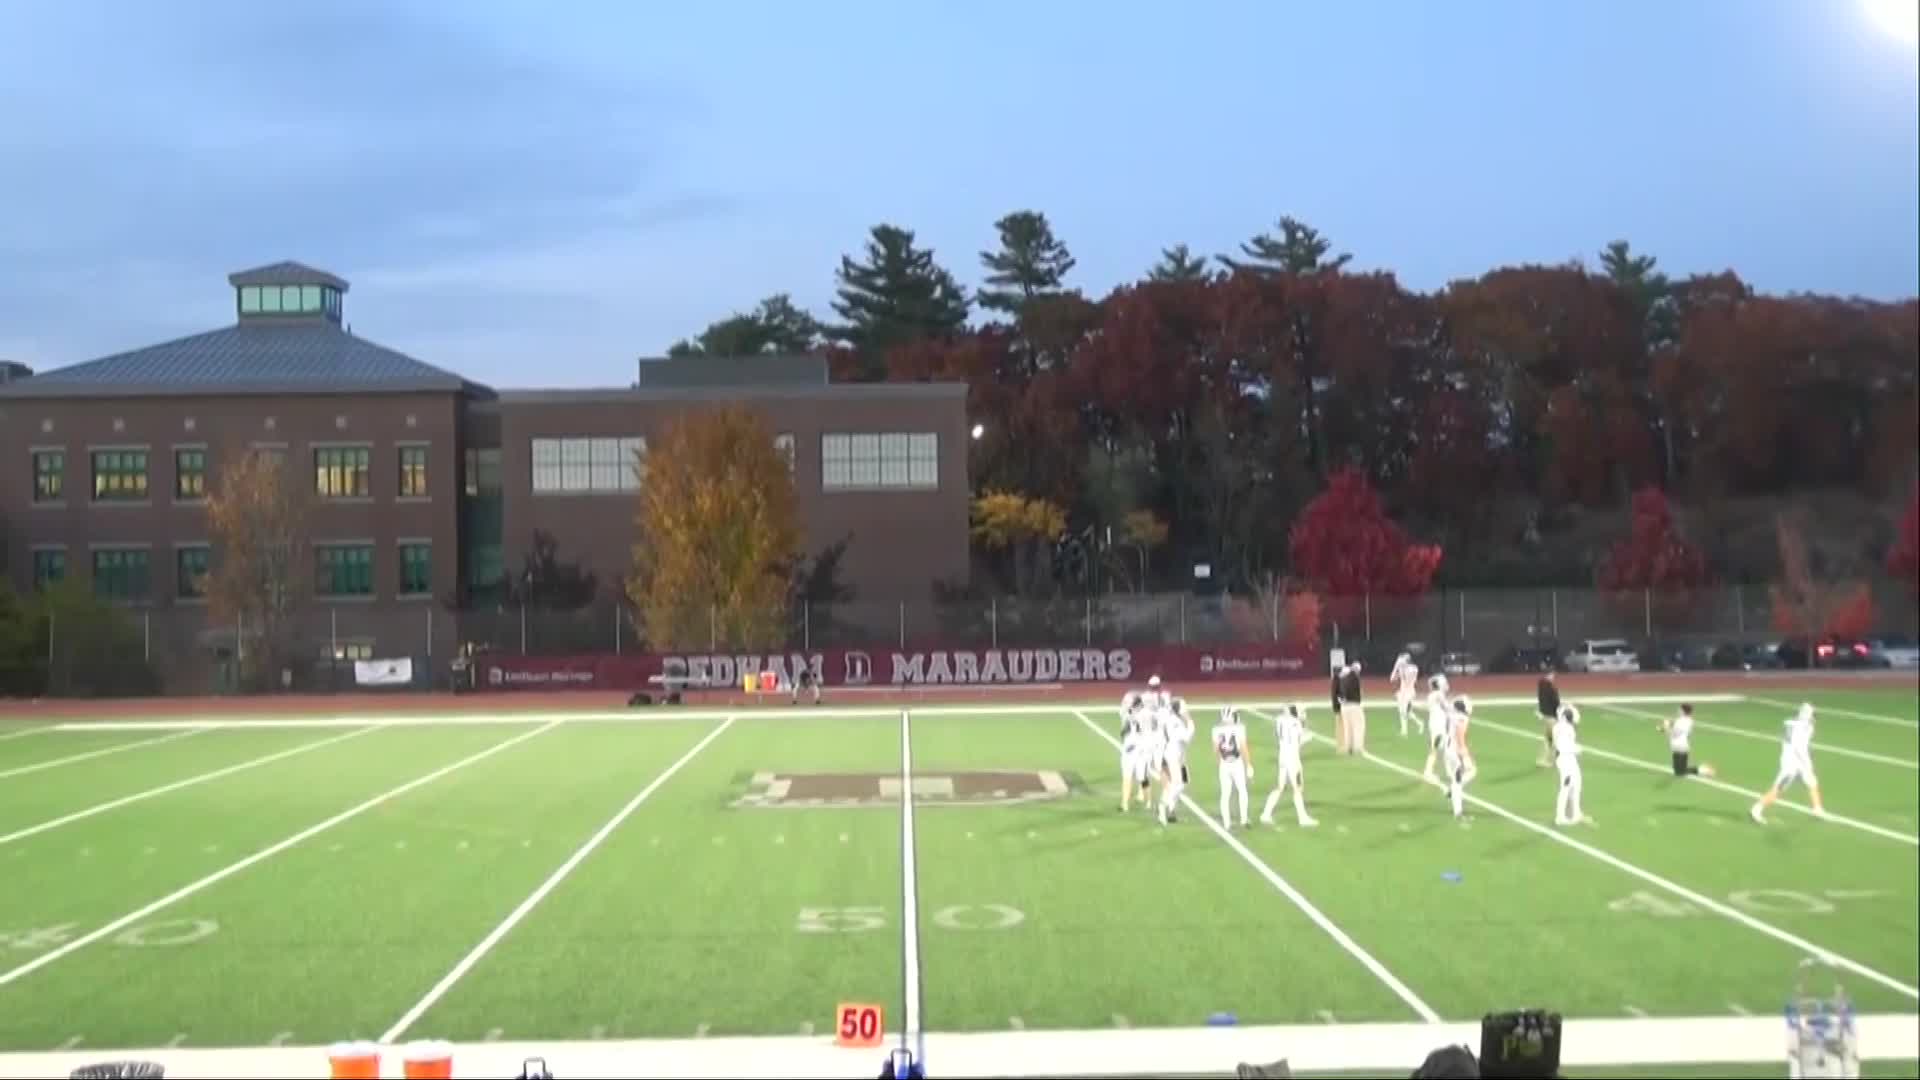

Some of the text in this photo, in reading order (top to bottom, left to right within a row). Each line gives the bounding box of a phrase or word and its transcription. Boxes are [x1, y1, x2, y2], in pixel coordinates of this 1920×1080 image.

[891, 649, 1132, 684] MARAUDERS
[795, 904, 1026, 934] 50
[839, 1007, 878, 1042] 50
